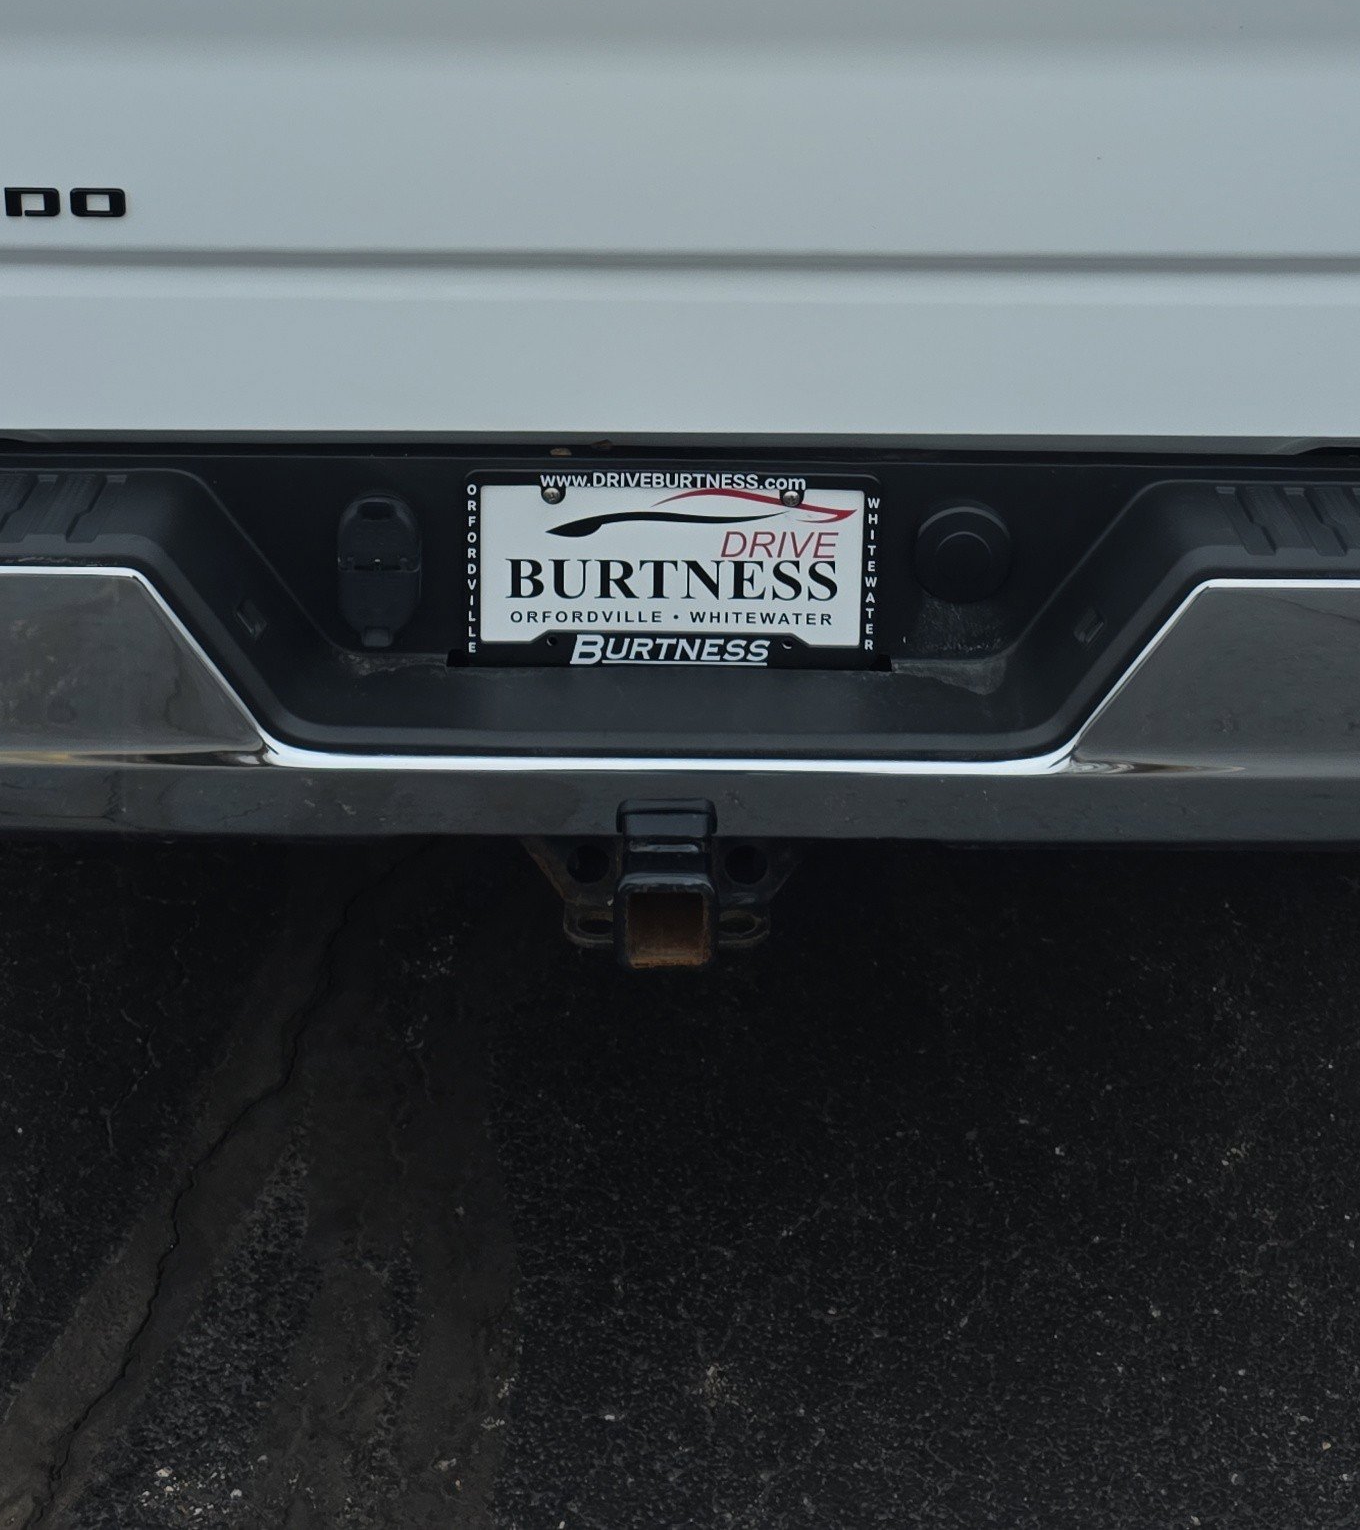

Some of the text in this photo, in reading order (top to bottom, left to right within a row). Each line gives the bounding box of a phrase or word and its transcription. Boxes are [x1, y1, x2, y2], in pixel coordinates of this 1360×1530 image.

[539, 472, 807, 492] www.DRIVEBURTNESS.com
[720, 530, 840, 559] DRIVE
[466, 483, 478, 654] ORFORDVILLE
[504, 558, 839, 602] BURTNESS
[863, 497, 881, 652] WHITEWATER
[509, 610, 833, 626] ORFORDVILLE WHITEWATER
